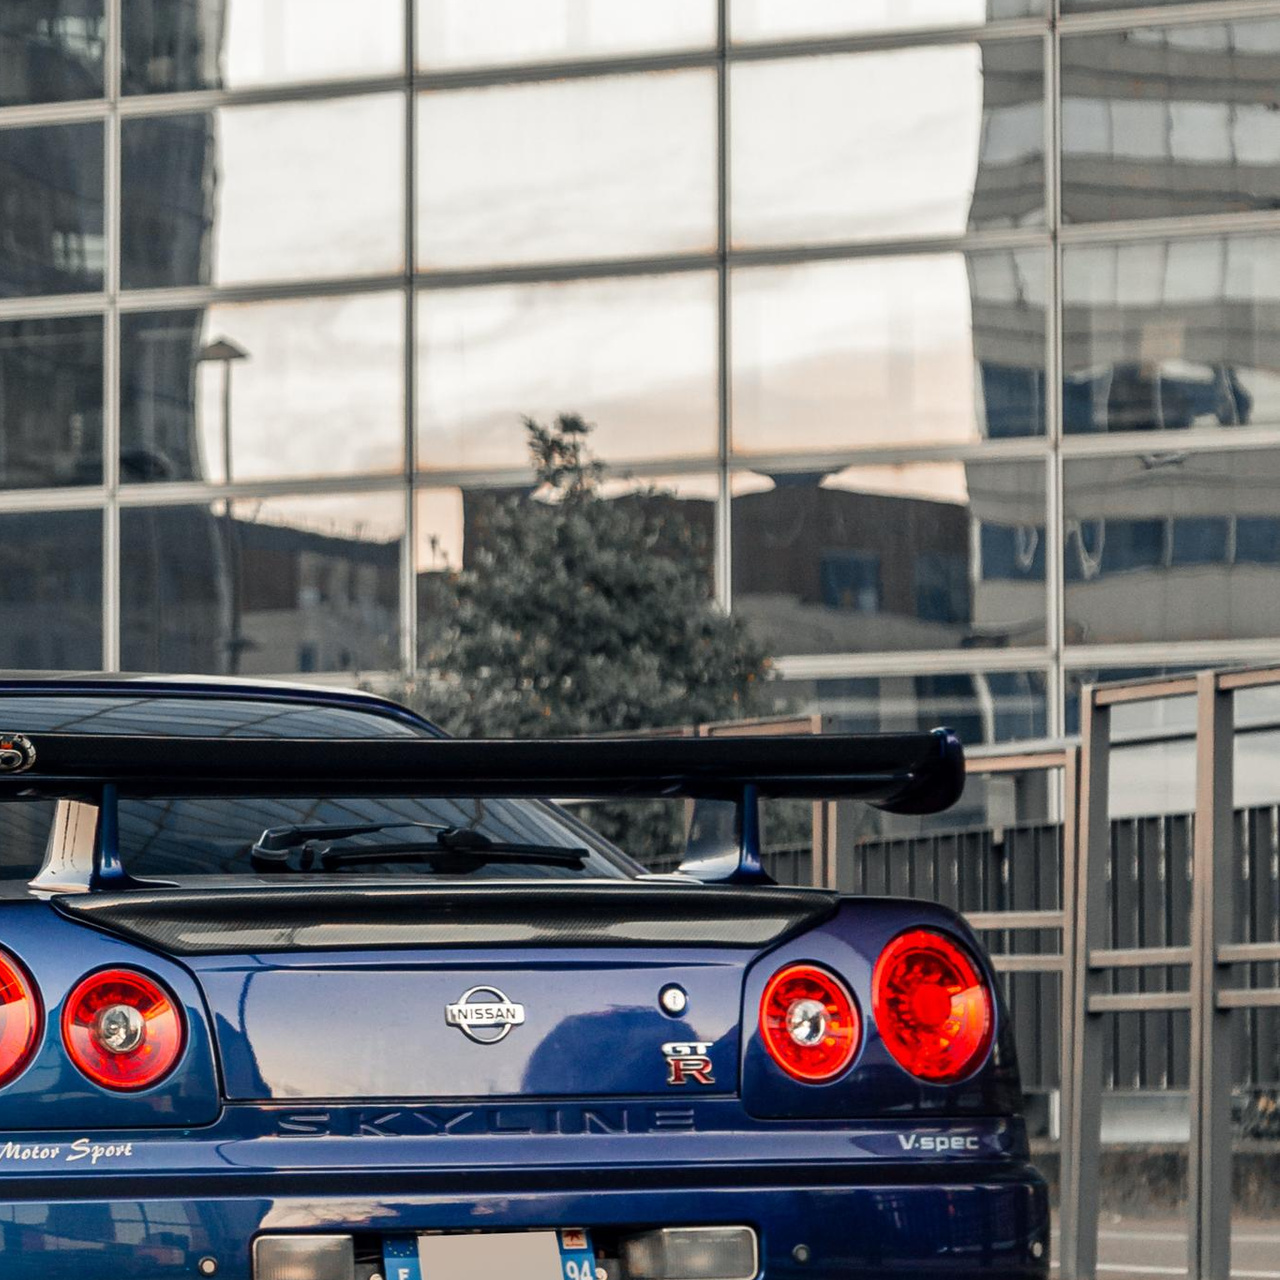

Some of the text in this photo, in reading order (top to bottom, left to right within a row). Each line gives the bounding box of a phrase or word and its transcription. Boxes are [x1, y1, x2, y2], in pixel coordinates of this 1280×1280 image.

[457, 1007, 516, 1020] NISSAN
[661, 1041, 714, 1055] GT
[666, 1055, 716, 1085] R
[276, 1109, 695, 1137] SKYLINE
[65, 1137, 133, 1165] Sport
